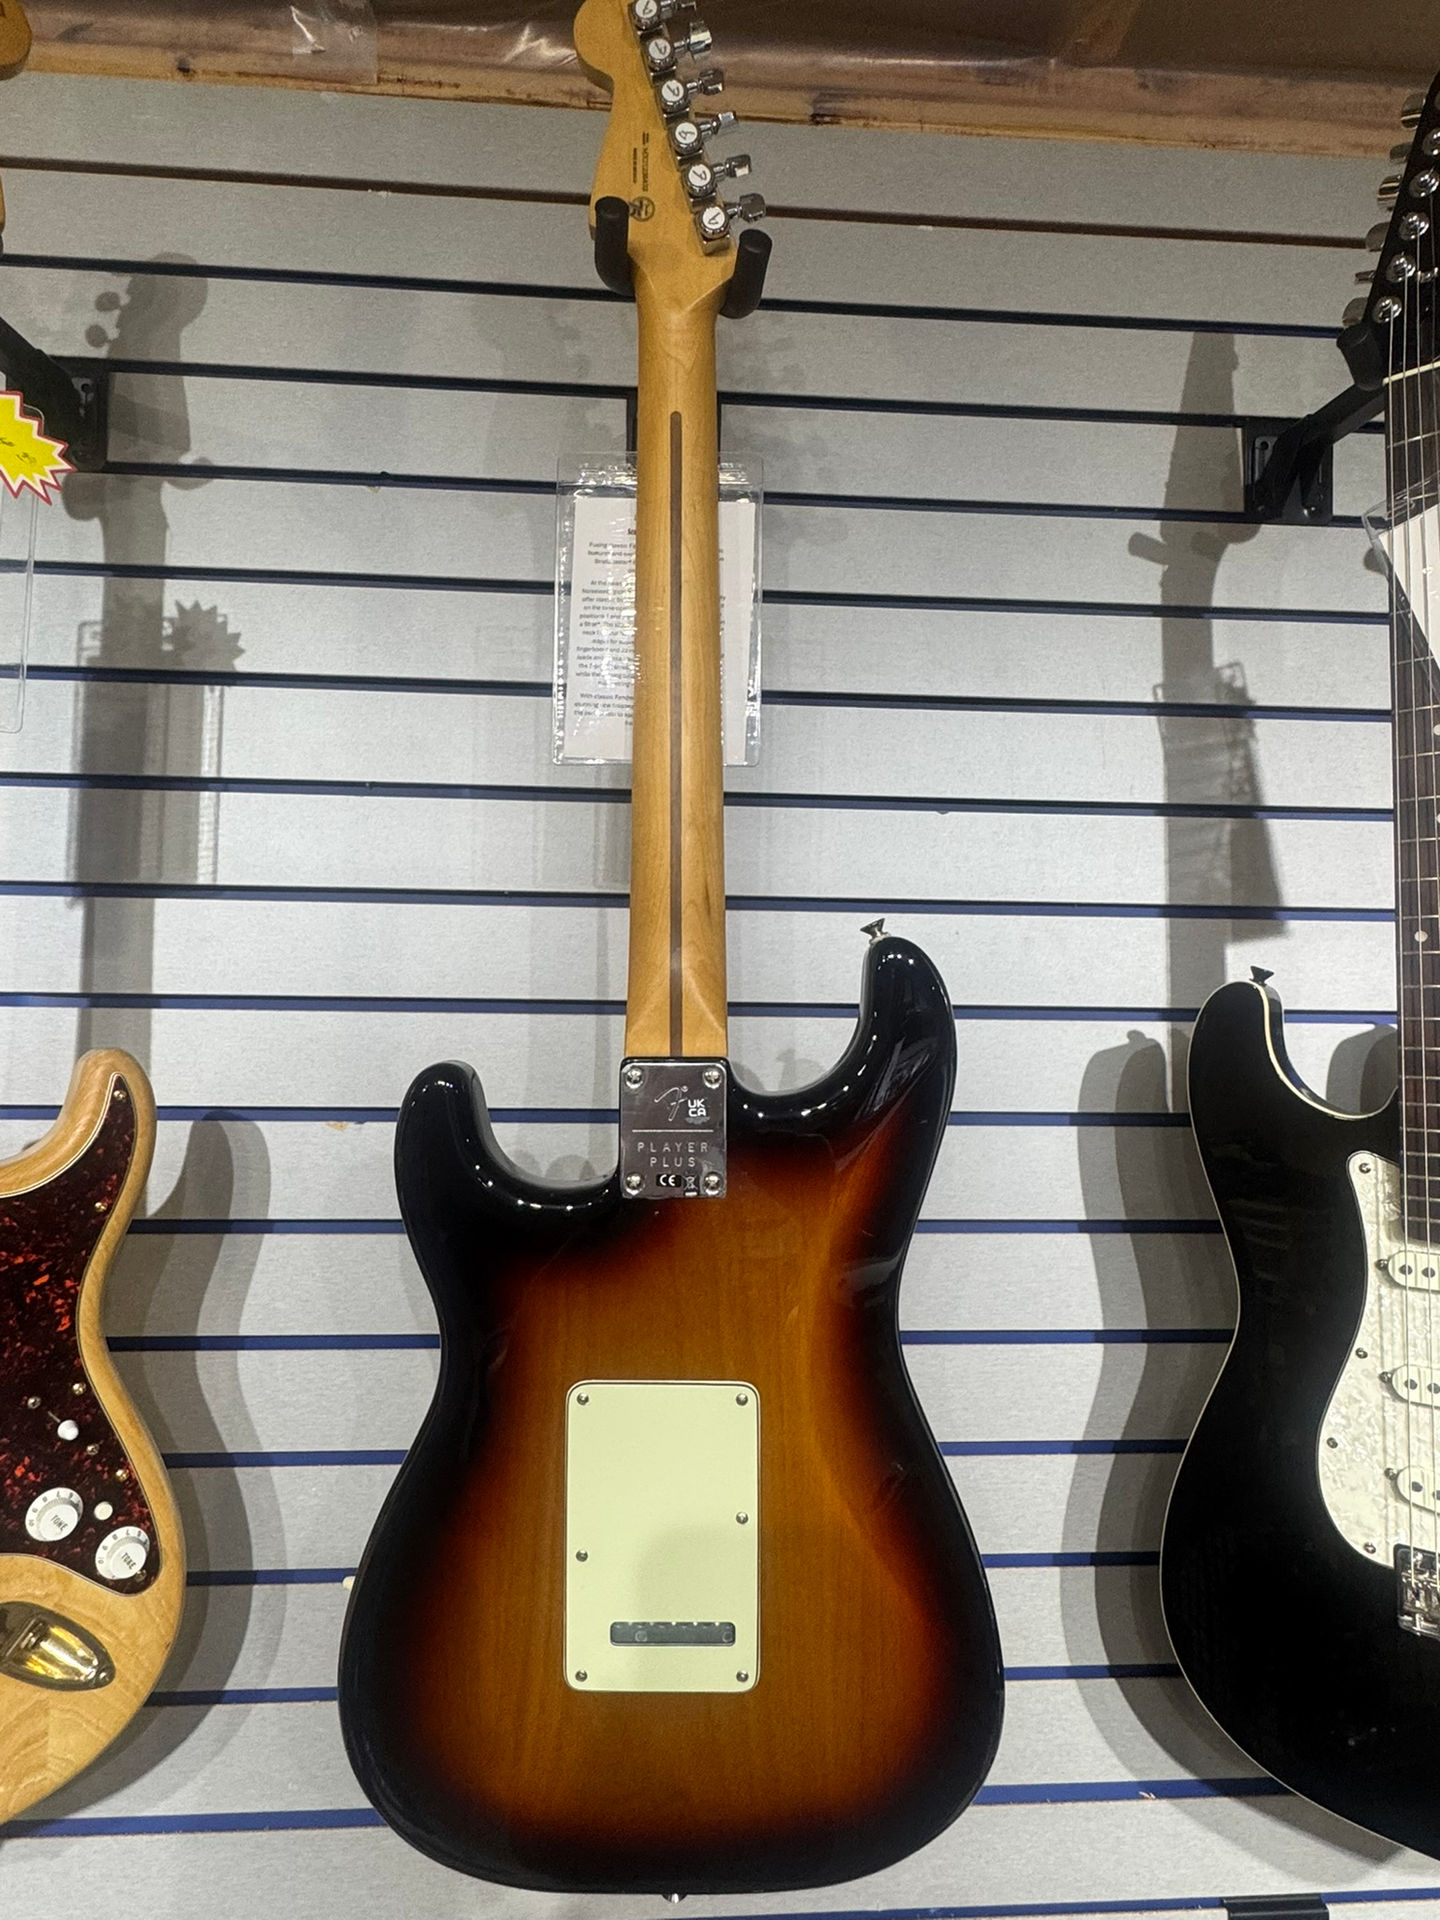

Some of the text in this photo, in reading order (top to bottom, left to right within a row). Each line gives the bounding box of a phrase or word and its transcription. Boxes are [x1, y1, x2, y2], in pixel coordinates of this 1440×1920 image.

[637, 1142, 709, 1152] PLAYER
[650, 1157, 697, 1168] PLUS
[50, 1514, 69, 1531] TONE
[121, 1552, 137, 1570] TONE
